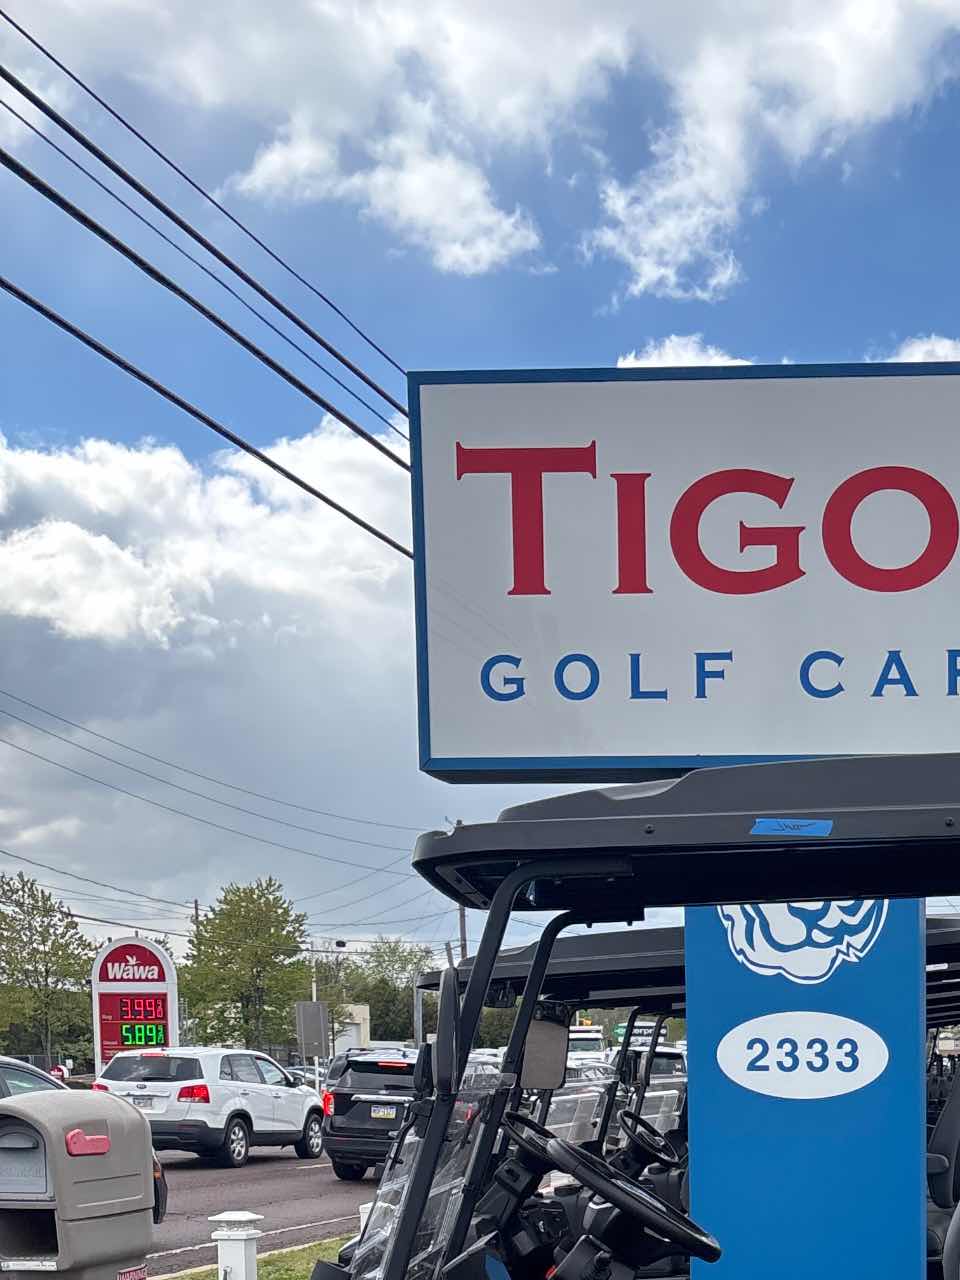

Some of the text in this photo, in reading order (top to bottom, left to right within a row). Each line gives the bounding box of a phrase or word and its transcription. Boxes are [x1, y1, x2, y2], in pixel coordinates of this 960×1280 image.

[480, 650, 734, 702] GOLF
[106, 962, 158, 980] Wawa
[746, 1037, 860, 1073] 2333
